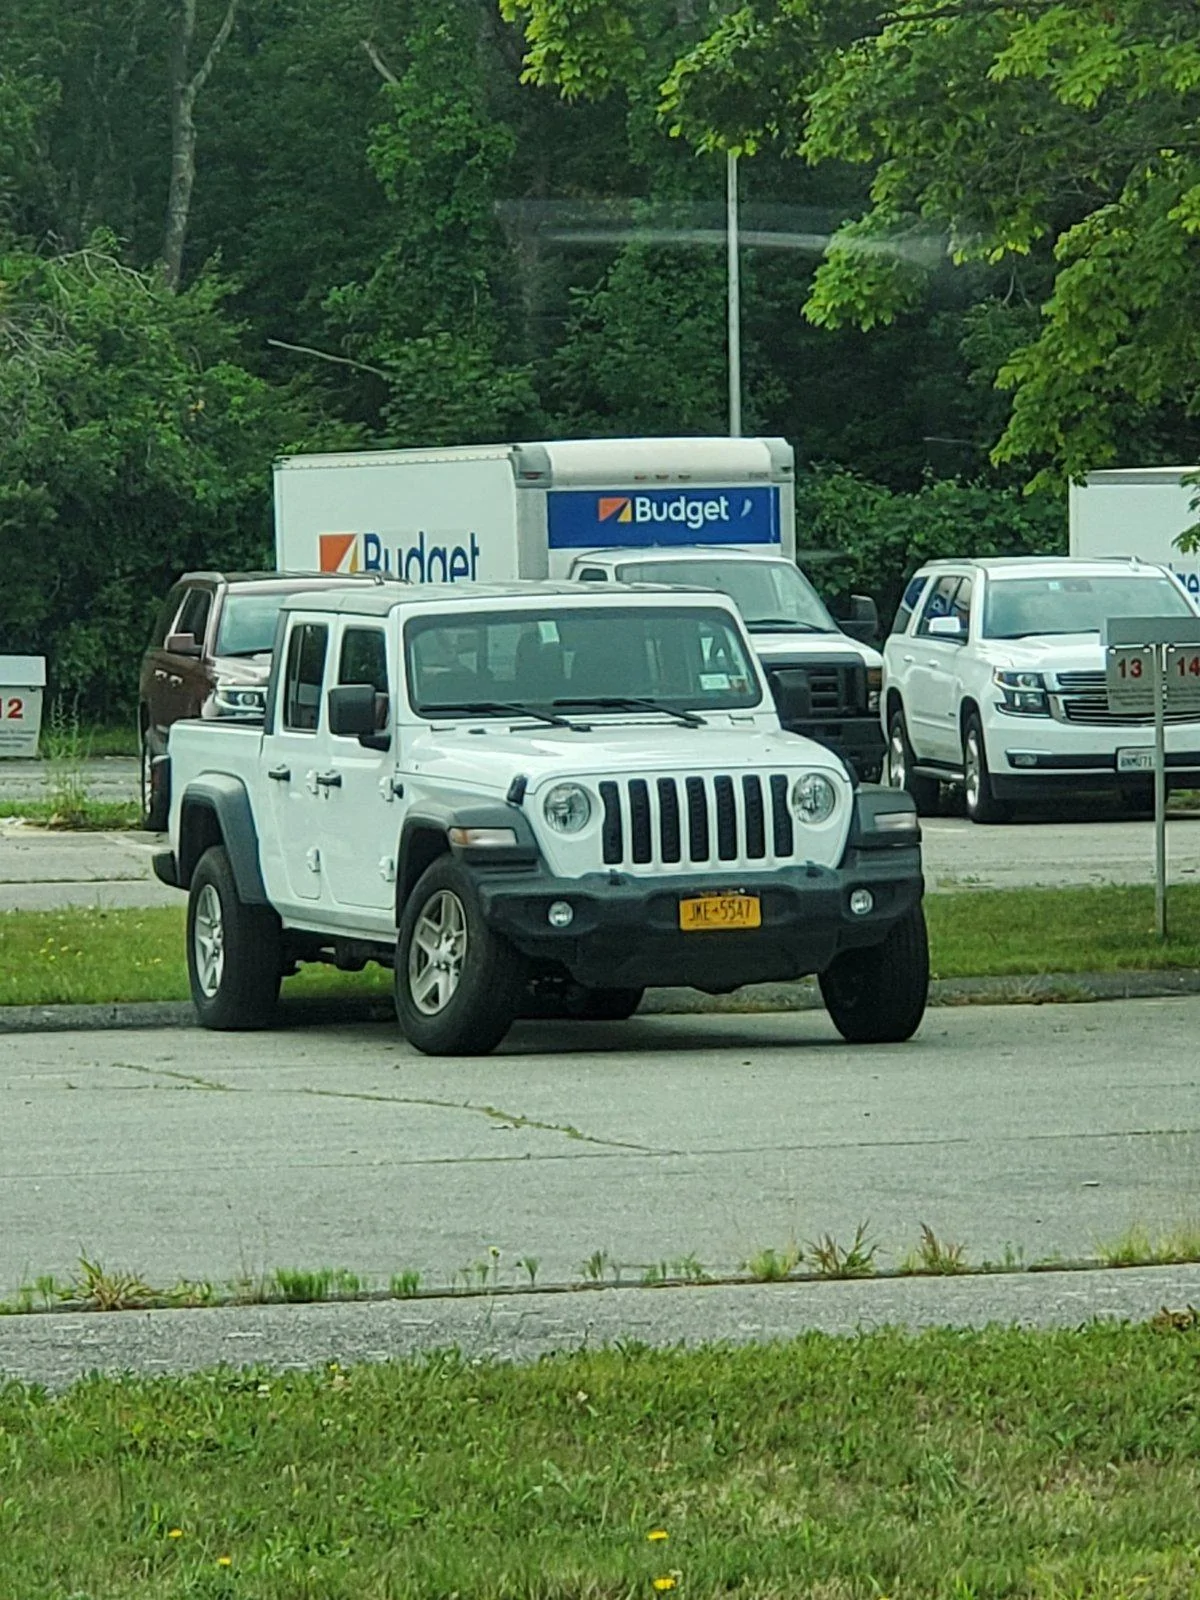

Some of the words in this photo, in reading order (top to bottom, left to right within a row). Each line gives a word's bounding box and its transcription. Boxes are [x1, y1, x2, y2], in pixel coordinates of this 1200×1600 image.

[635, 496, 730, 529] Budget
[1118, 658, 1142, 678] 13
[1177, 657, 1200, 677] 14
